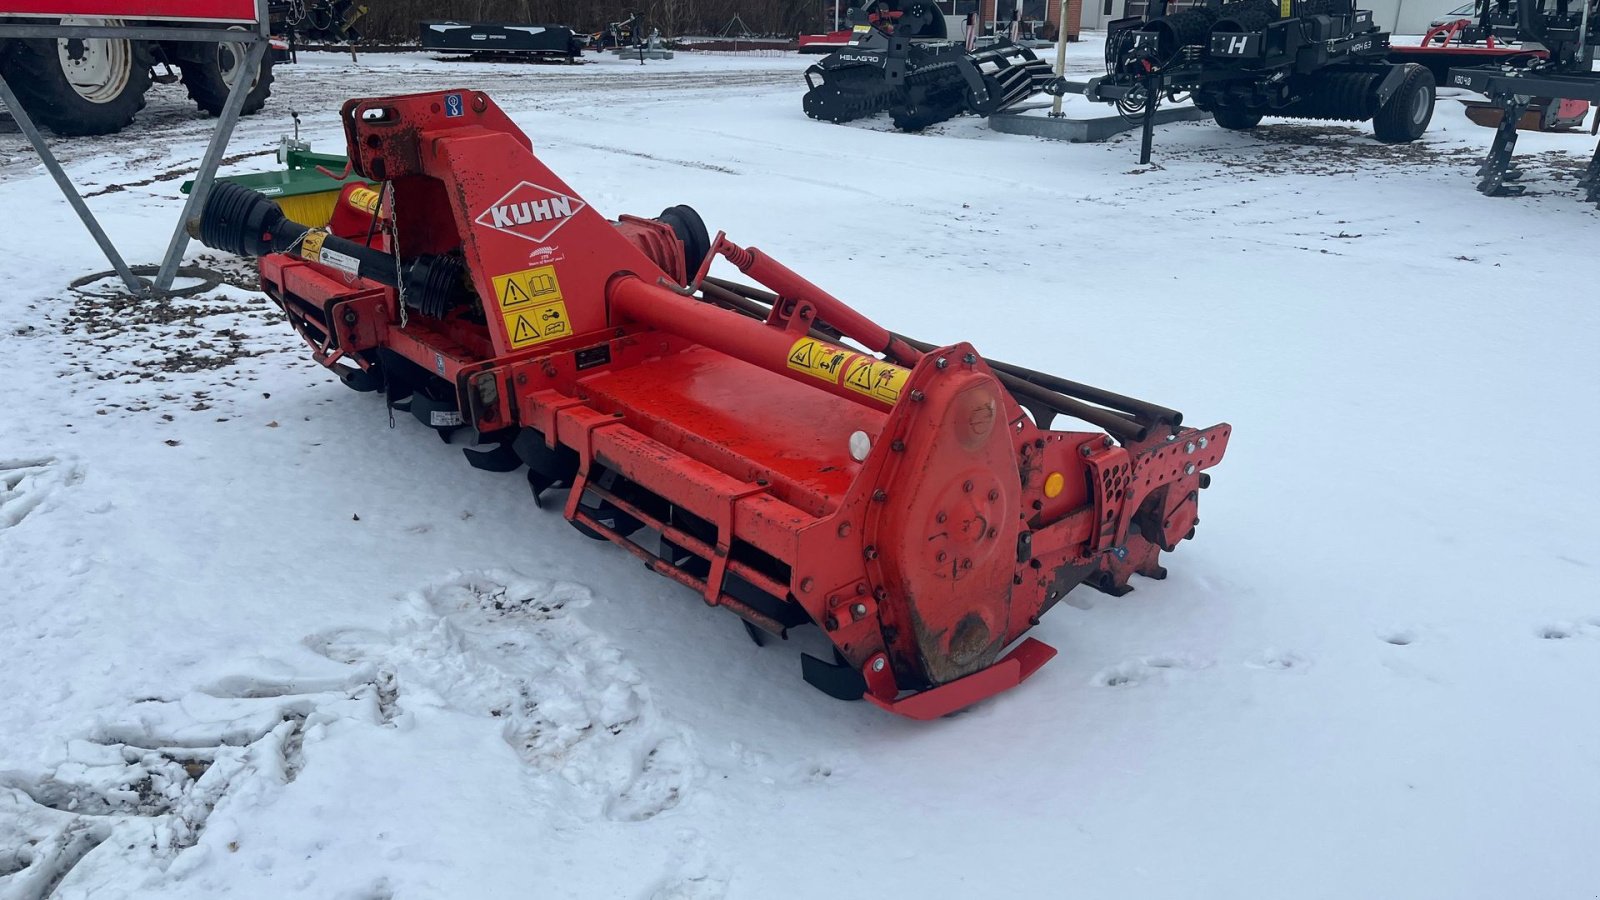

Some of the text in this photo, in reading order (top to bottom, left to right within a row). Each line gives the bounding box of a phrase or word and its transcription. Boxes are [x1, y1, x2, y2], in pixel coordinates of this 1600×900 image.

[1227, 36, 1248, 54] H
[839, 54, 879, 63] HELAGRO
[490, 196, 573, 228] KUHN
